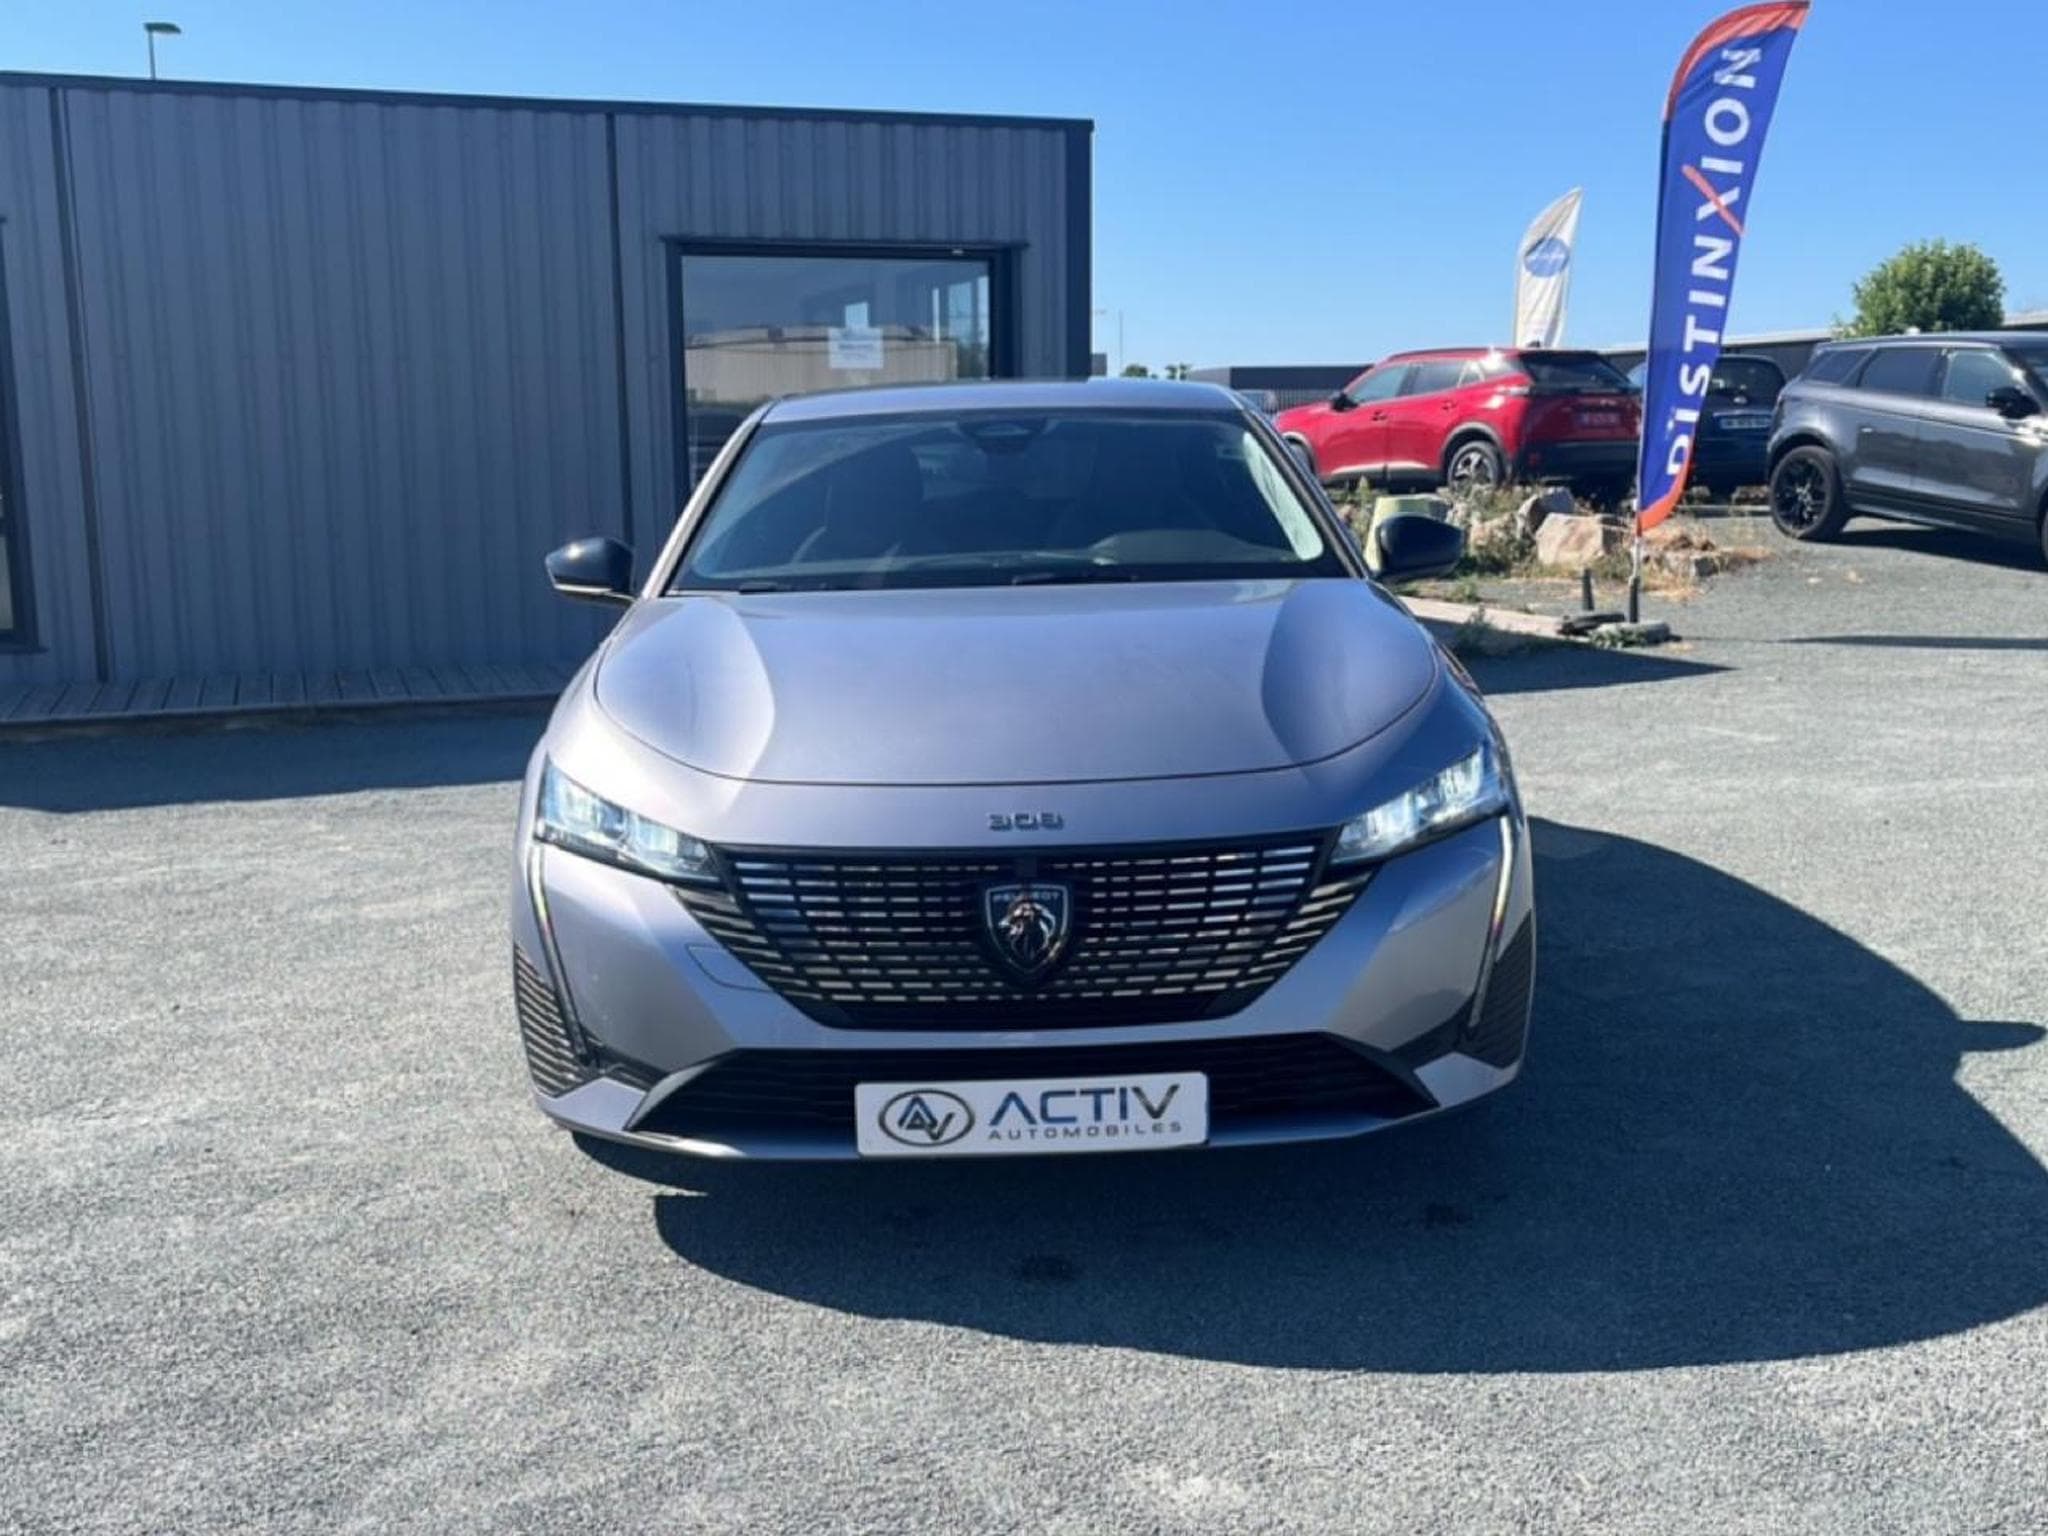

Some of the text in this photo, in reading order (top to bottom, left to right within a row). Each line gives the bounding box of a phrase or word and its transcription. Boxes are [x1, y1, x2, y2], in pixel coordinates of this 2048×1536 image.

[989, 812, 1064, 831] 308
[989, 1084, 1180, 1127] ACTIV
[989, 1122, 1182, 1141] AUTOMOBILES
